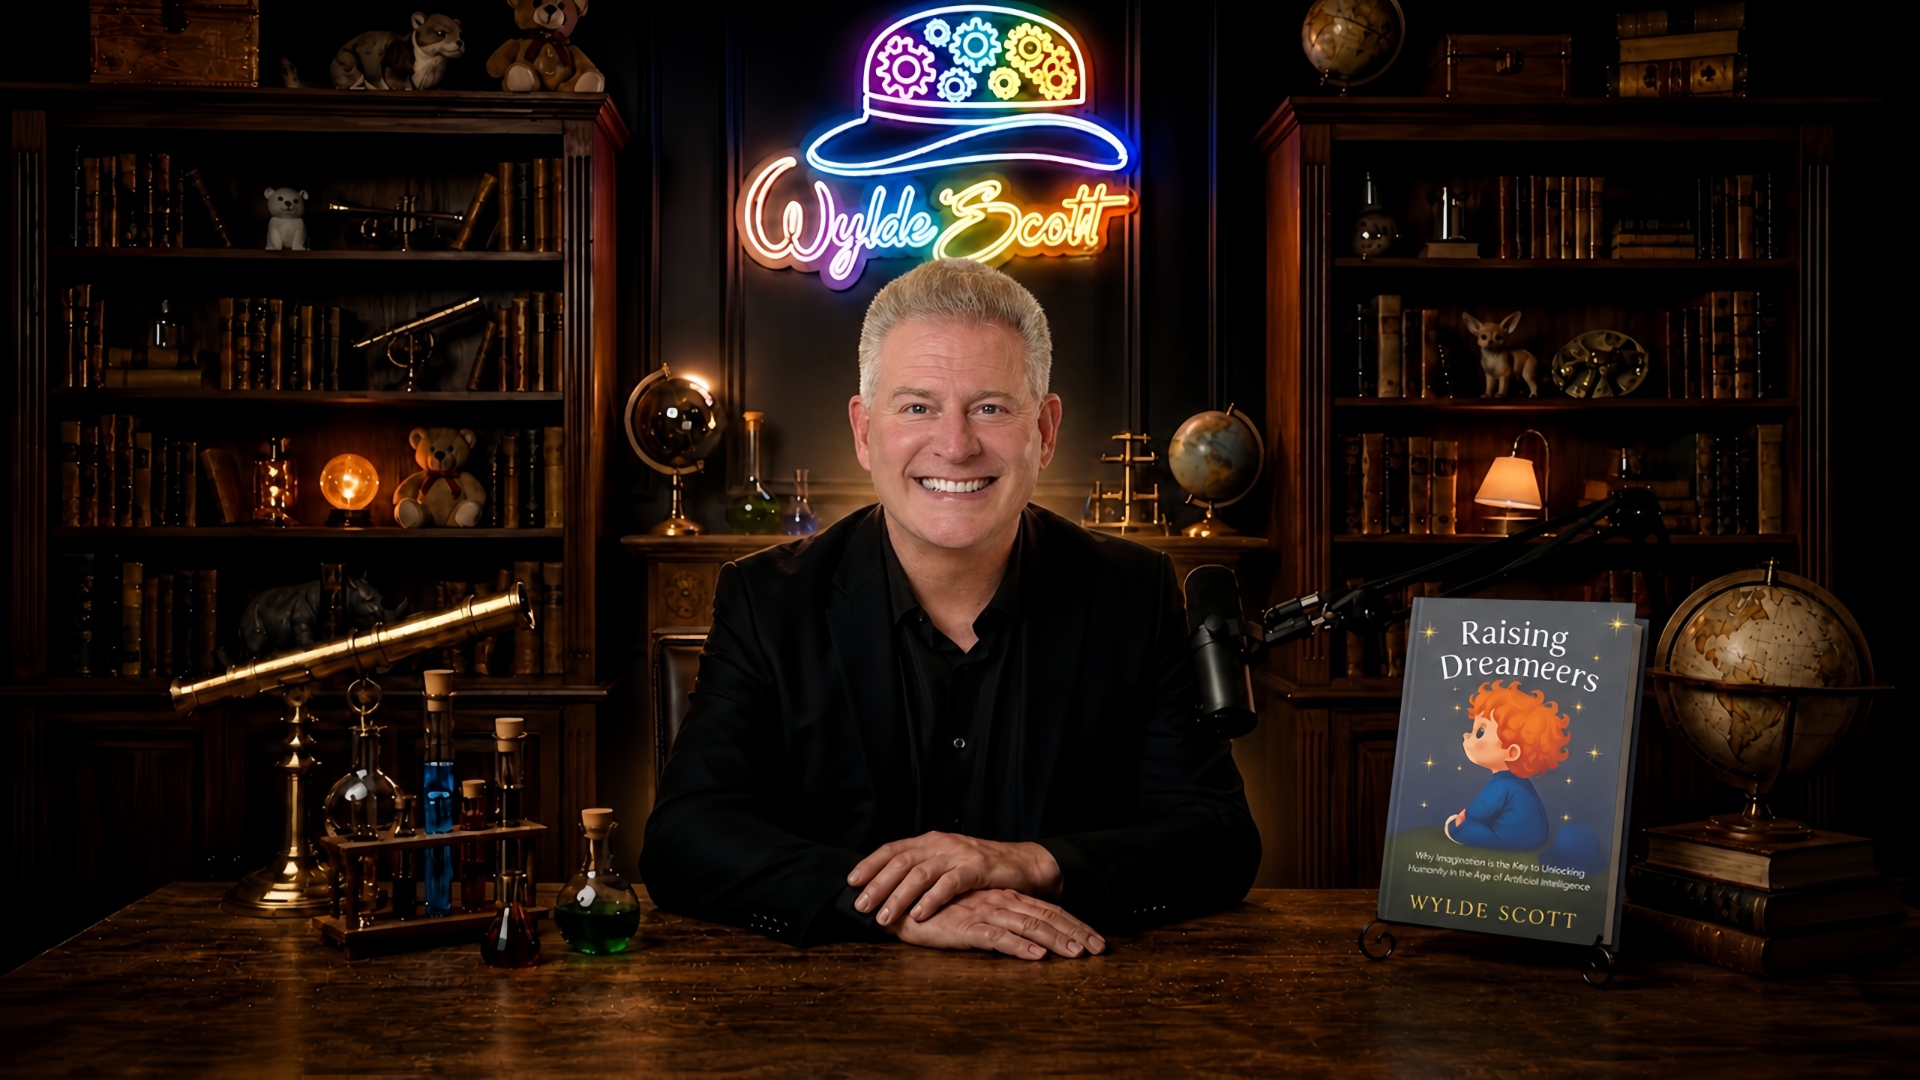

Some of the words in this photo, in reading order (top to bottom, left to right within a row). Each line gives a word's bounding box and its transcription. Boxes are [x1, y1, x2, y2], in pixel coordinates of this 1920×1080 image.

[745, 156, 938, 281] Wylde
[932, 179, 1130, 262] Scott
[1461, 619, 1569, 657] Raising
[1440, 654, 1600, 692] Dreameers
[1408, 864, 1448, 878] Humanity
[1449, 868, 1457, 876] in
[1459, 869, 1473, 878] the
[1474, 870, 1491, 882] Age
[1492, 872, 1502, 881] of
[1503, 874, 1540, 886] Artificial
[1540, 878, 1591, 892] Intelligence
[1415, 851, 1434, 863] Why
[1435, 853, 1486, 867] Imagination
[1487, 858, 1494, 867] is
[1496, 860, 1510, 869] the
[1512, 861, 1529, 873] Key
[1530, 863, 1540, 872] to
[1541, 864, 1585, 879] Unlocking
[1410, 894, 1488, 919] WYLDE
[1498, 905, 1578, 929] SCOTT
